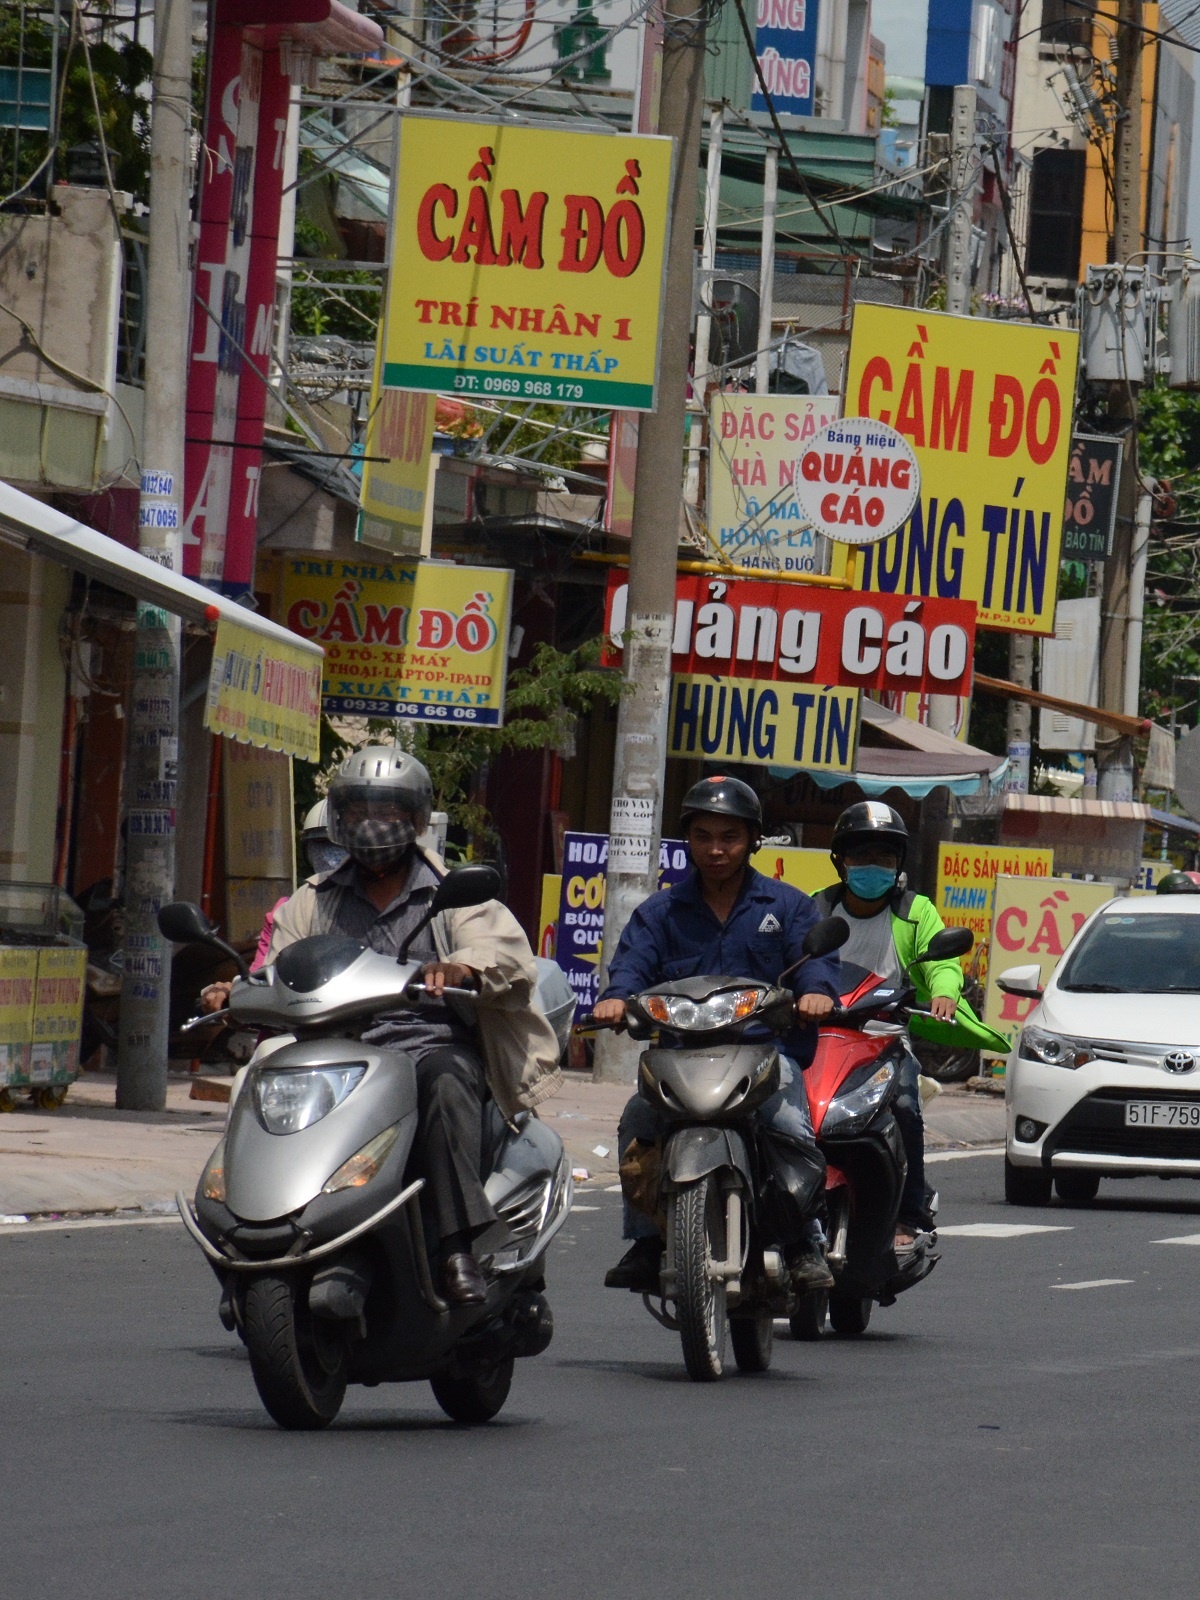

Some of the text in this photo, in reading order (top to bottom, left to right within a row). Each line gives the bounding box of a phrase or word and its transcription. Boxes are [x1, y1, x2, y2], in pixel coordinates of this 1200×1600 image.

[417, 146, 646, 278] CẦM ĐỒ
[415, 296, 633, 341] TRÍ NHÂN 1
[424, 338, 619, 374] LÃI SUẤT THẤP
[454, 375, 584, 399] ĐT: 0969 968 179
[858, 324, 1061, 466] CẦM ĐỒ
[720, 406, 775, 447] ĐẶC
[827, 429, 897, 448] Bảng Hiệu
[732, 451, 768, 487] HÀ
[801, 445, 912, 490] QUẢNG
[1069, 442, 1112, 486] ẦM
[769, 501, 807, 521] MA
[820, 488, 885, 527] CÁO
[982, 476, 1051, 616] TÍN
[291, 560, 417, 584] TRÍ NHÂN
[287, 580, 498, 655] CẦM ĐỒ
[841, 601, 967, 681] Cáo
[410, 652, 451, 668] MÁY
[338, 679, 491, 705] XUẤT THẤP
[343, 698, 390, 712] 0932
[395, 703, 419, 715] 06
[424, 705, 448, 717] 66
[453, 708, 477, 719] 06
[672, 675, 779, 760] HÙNG
[792, 684, 853, 766] TÍN
[943, 851, 969, 883] ĐẶC
[974, 851, 999, 879] SẢN
[943, 886, 987, 911] THANH
[573, 929, 603, 945] QU
